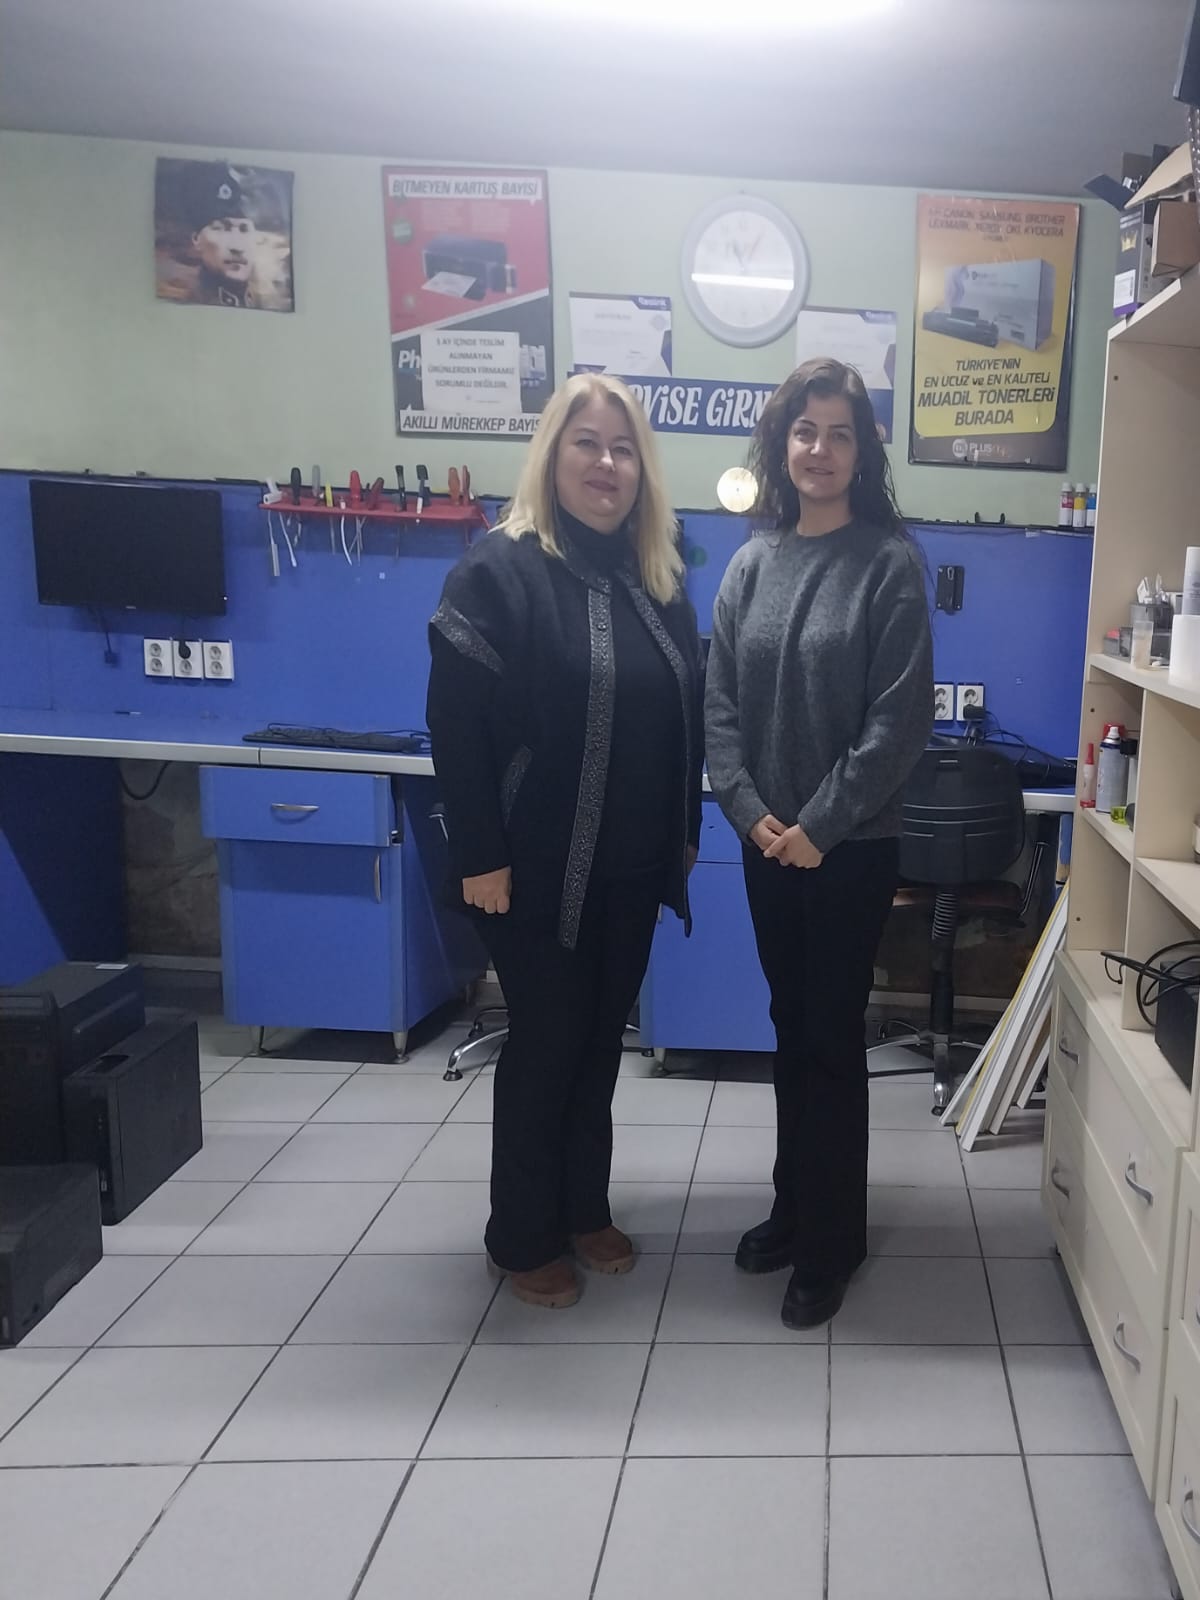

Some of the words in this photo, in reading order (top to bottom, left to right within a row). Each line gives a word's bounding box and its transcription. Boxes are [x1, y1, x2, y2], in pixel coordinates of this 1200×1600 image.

[449, 352, 493, 360] ALINMAYAN
[924, 376, 939, 388] EN
[941, 375, 970, 387] UCUZ
[972, 377, 985, 386] ve
[987, 374, 1002, 385] EN
[403, 415, 438, 430] AKILLI
[441, 413, 505, 431] MÜREKKEP
[954, 410, 1014, 426] BURADA
